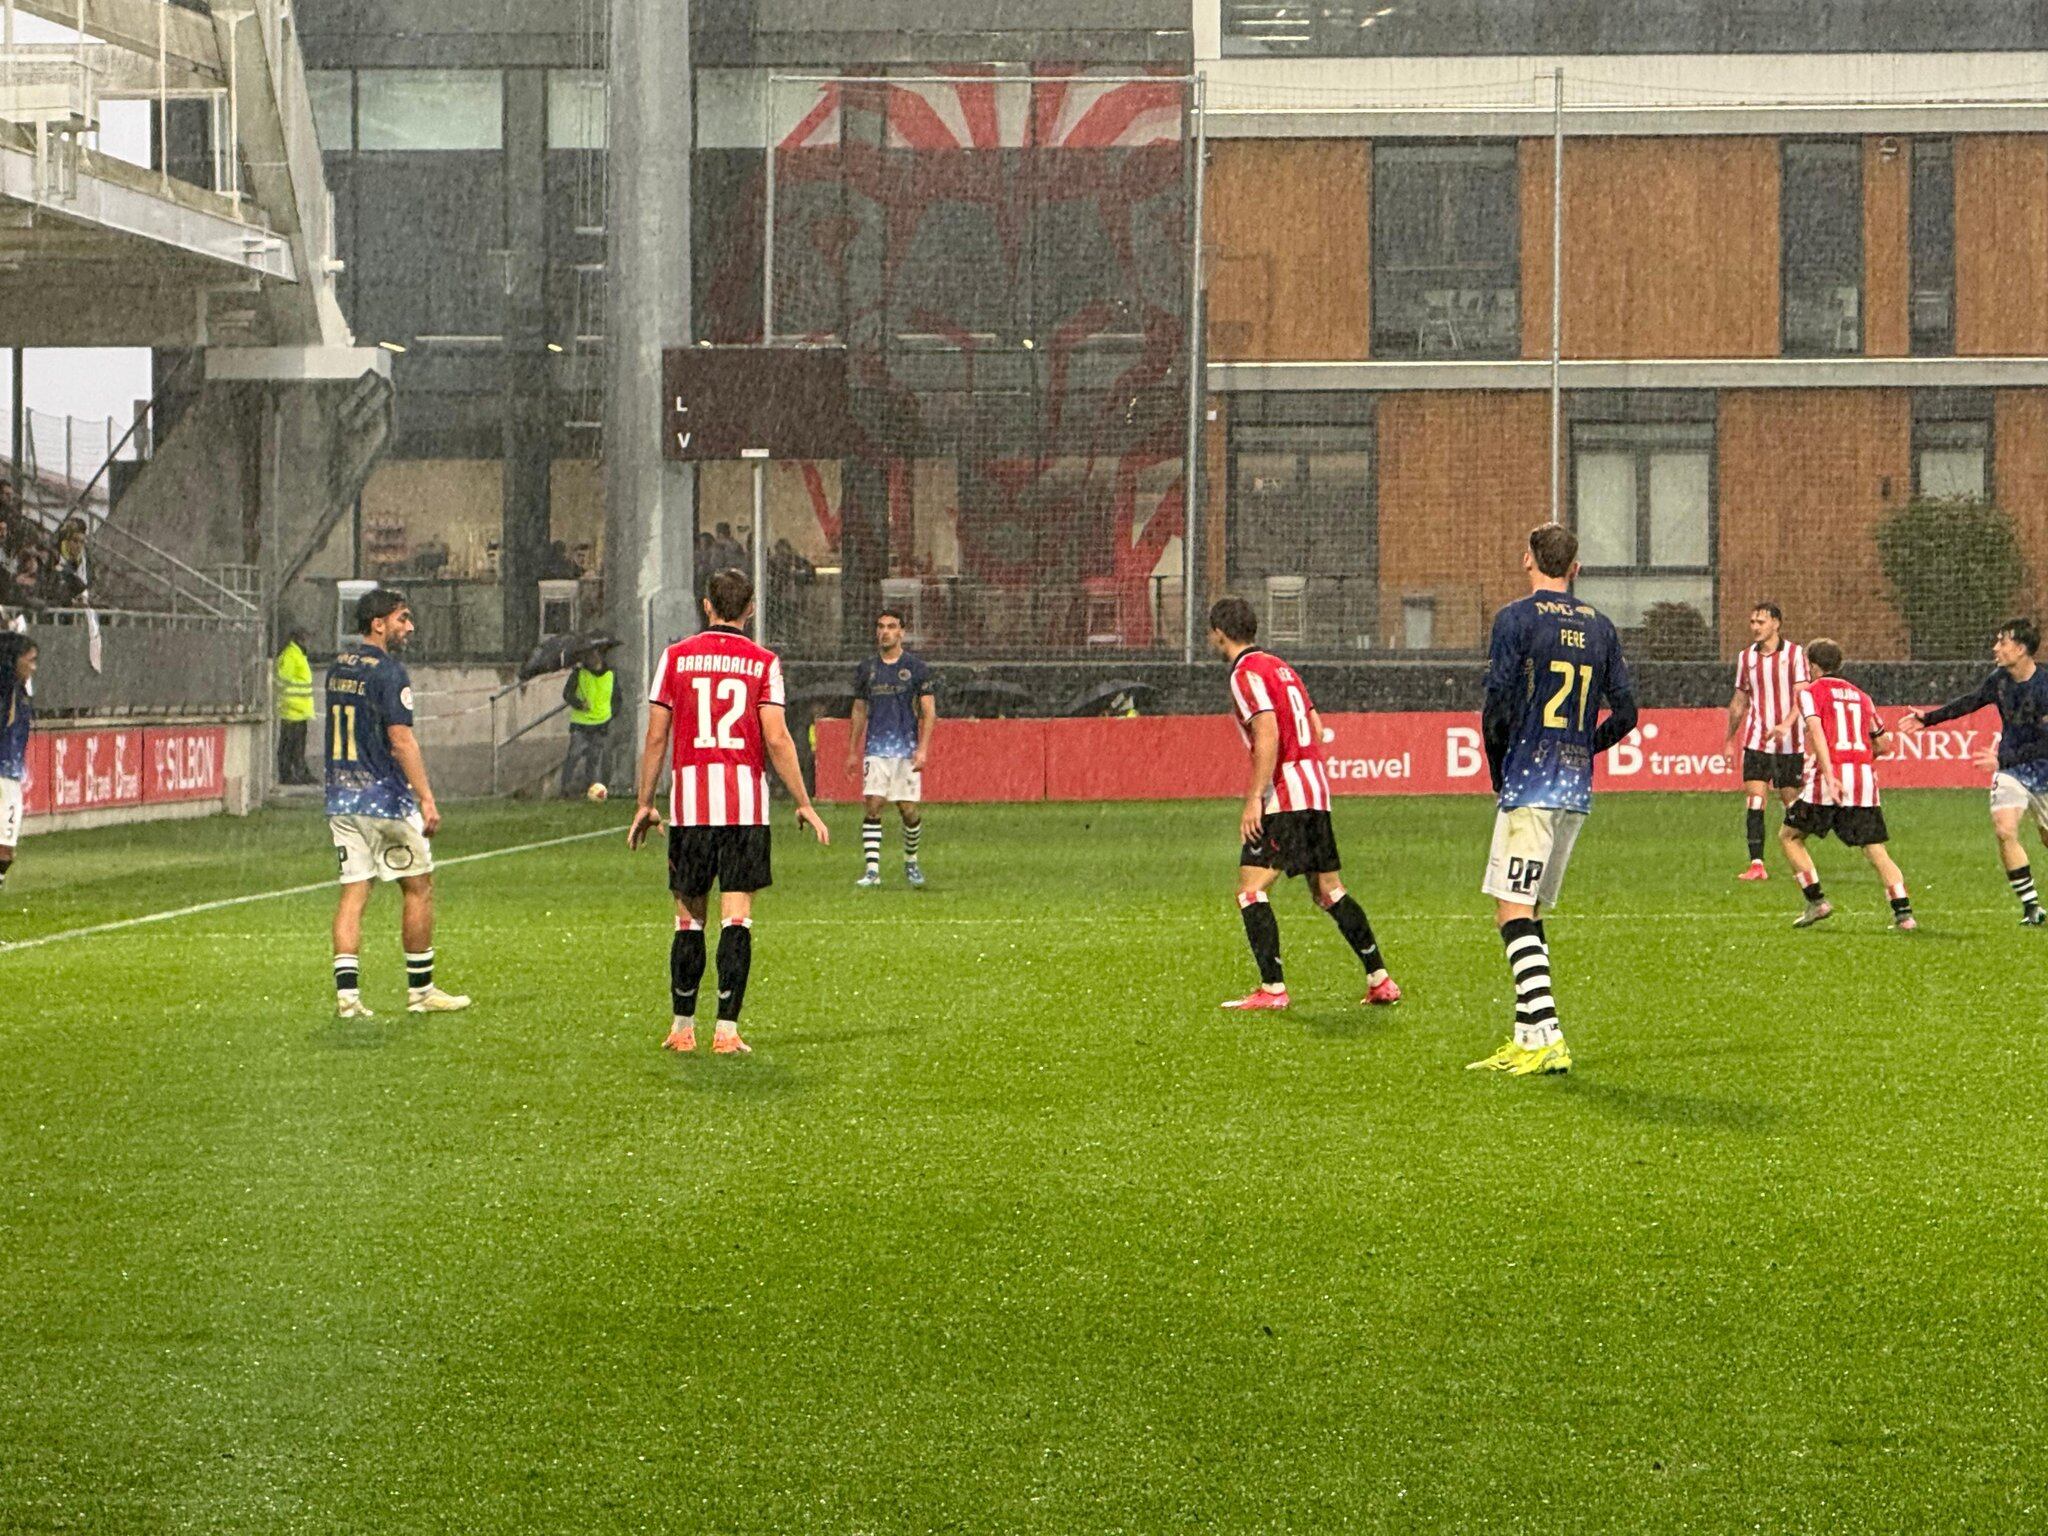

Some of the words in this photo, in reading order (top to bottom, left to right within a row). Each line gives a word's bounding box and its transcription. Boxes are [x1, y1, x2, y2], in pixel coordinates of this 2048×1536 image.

[676, 396, 688, 412] L
[677, 432, 691, 448] V
[1560, 628, 1586, 650] PERE
[677, 654, 764, 678] BARANDALLA
[691, 677, 748, 750] 12
[1287, 685, 1312, 748] 8
[1543, 660, 1593, 732] 21
[332, 704, 358, 761] 11
[1607, 726, 1643, 776] B
[1833, 701, 1868, 751] 11
[166, 736, 216, 792] SILBON
[1326, 752, 1411, 779] travel
[1446, 727, 1482, 777] B
